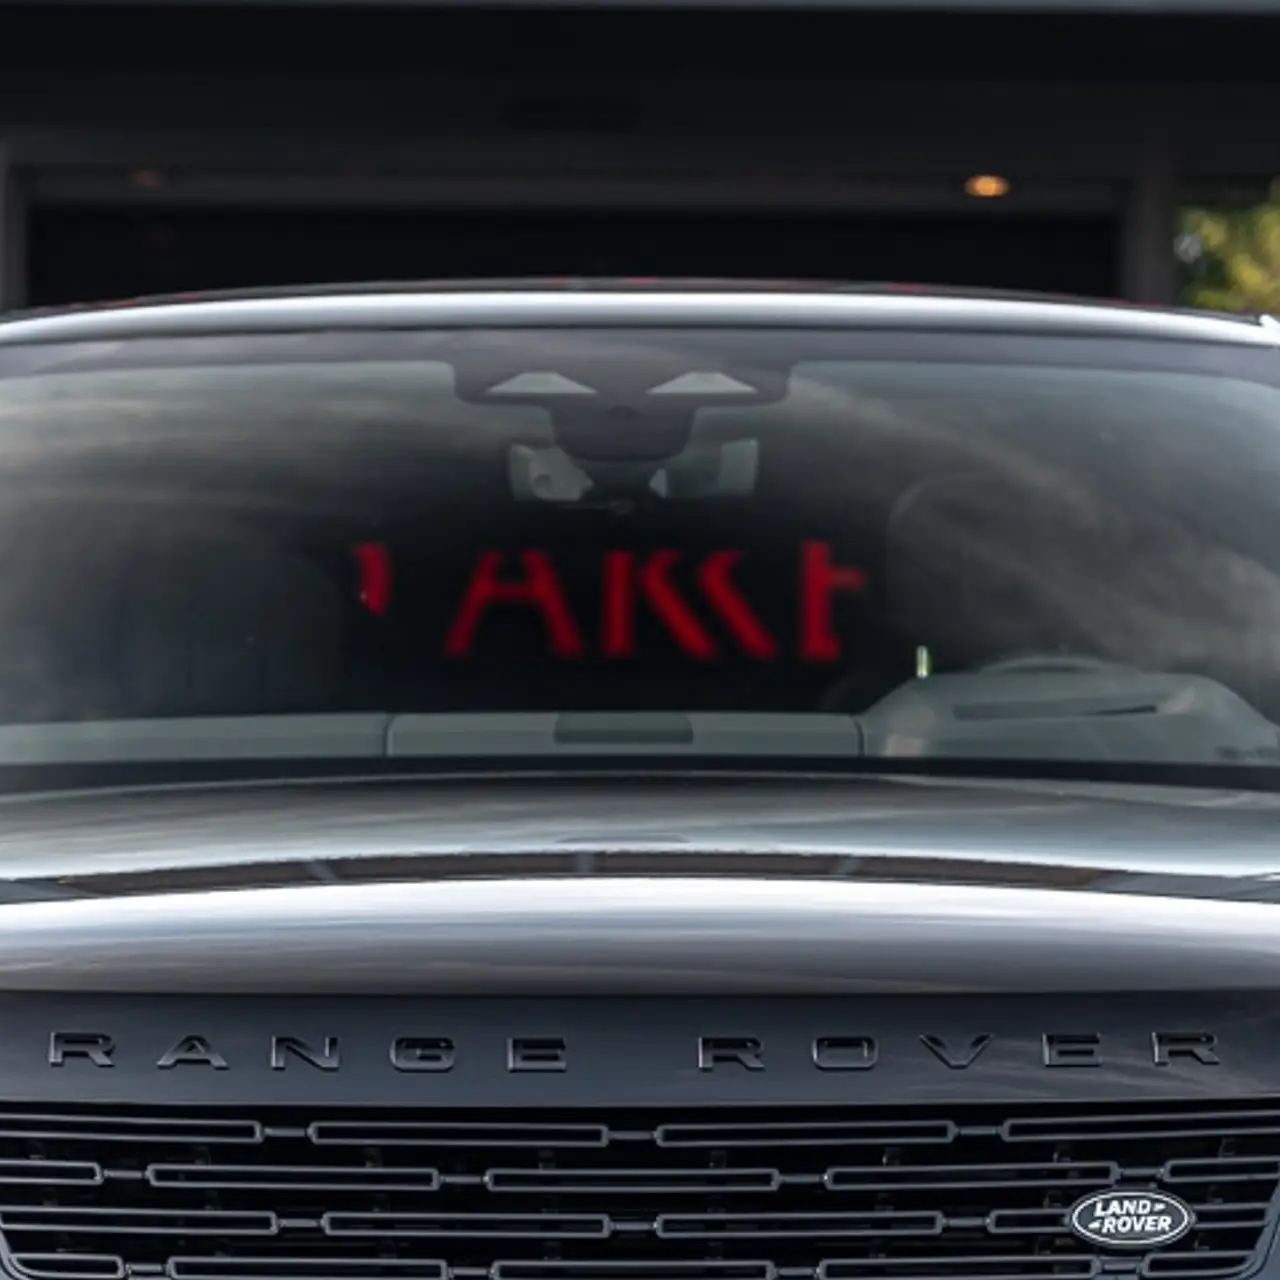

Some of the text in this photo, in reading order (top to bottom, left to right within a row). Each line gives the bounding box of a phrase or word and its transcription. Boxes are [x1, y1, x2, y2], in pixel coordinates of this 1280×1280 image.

[47, 1030, 1220, 1073] RANGE ROVER
[1093, 1199, 1152, 1217] LAND
[1101, 1216, 1173, 1234] ROVER
